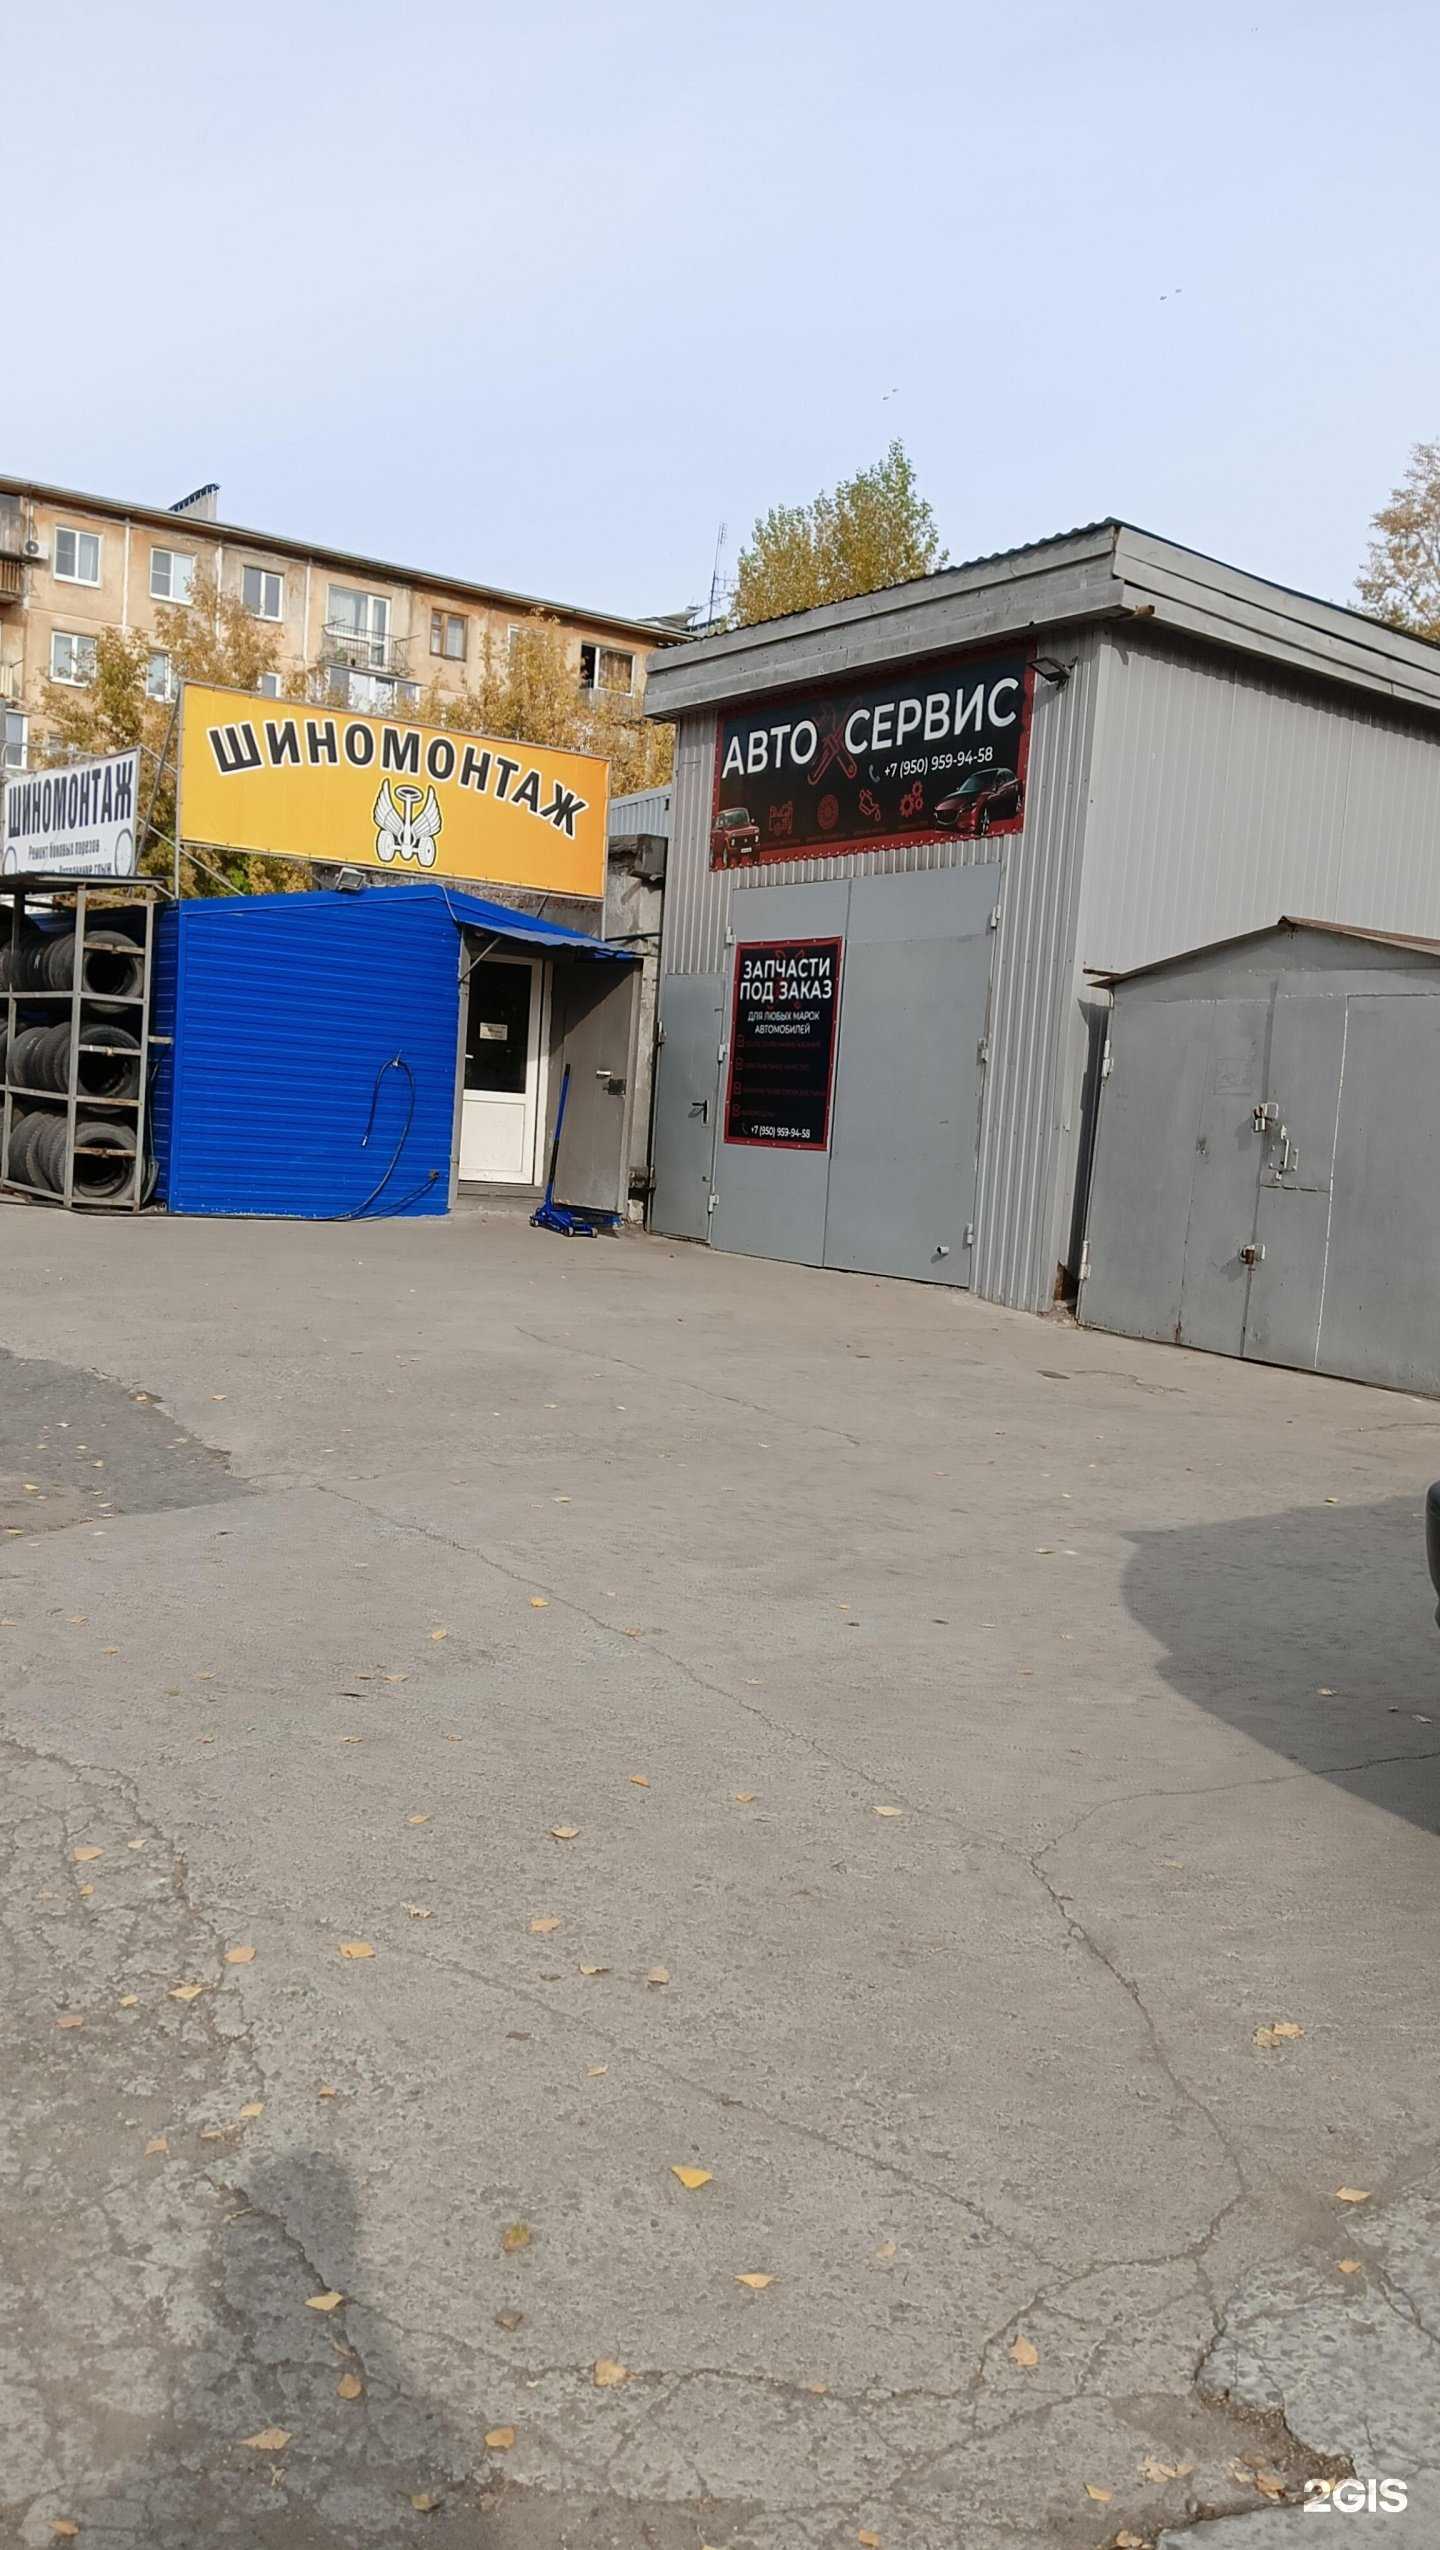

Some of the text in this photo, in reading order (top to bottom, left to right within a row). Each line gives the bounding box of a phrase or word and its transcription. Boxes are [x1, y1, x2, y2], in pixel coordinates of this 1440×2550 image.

[722, 677, 1019, 779] АВТО СЕРВИС
[884, 746, 993, 779] +7 (950) 959-94-58
[207, 718, 588, 838] ШИНОМОНТАЖ
[8, 760, 133, 838] ШИНОМОНТАЖ
[743, 958, 830, 979] ЗАПЧАСТИ
[740, 980, 832, 1003] ПОД ЗАКАЗ
[747, 1011, 820, 1022] ДЛЯ ЛЮБЫХ МАРОК
[754, 1022, 811, 1034] АВТОМОБИЛЕЙ
[759, 1126, 776, 1137] (950)
[776, 1127, 811, 1138] 959-94-58
